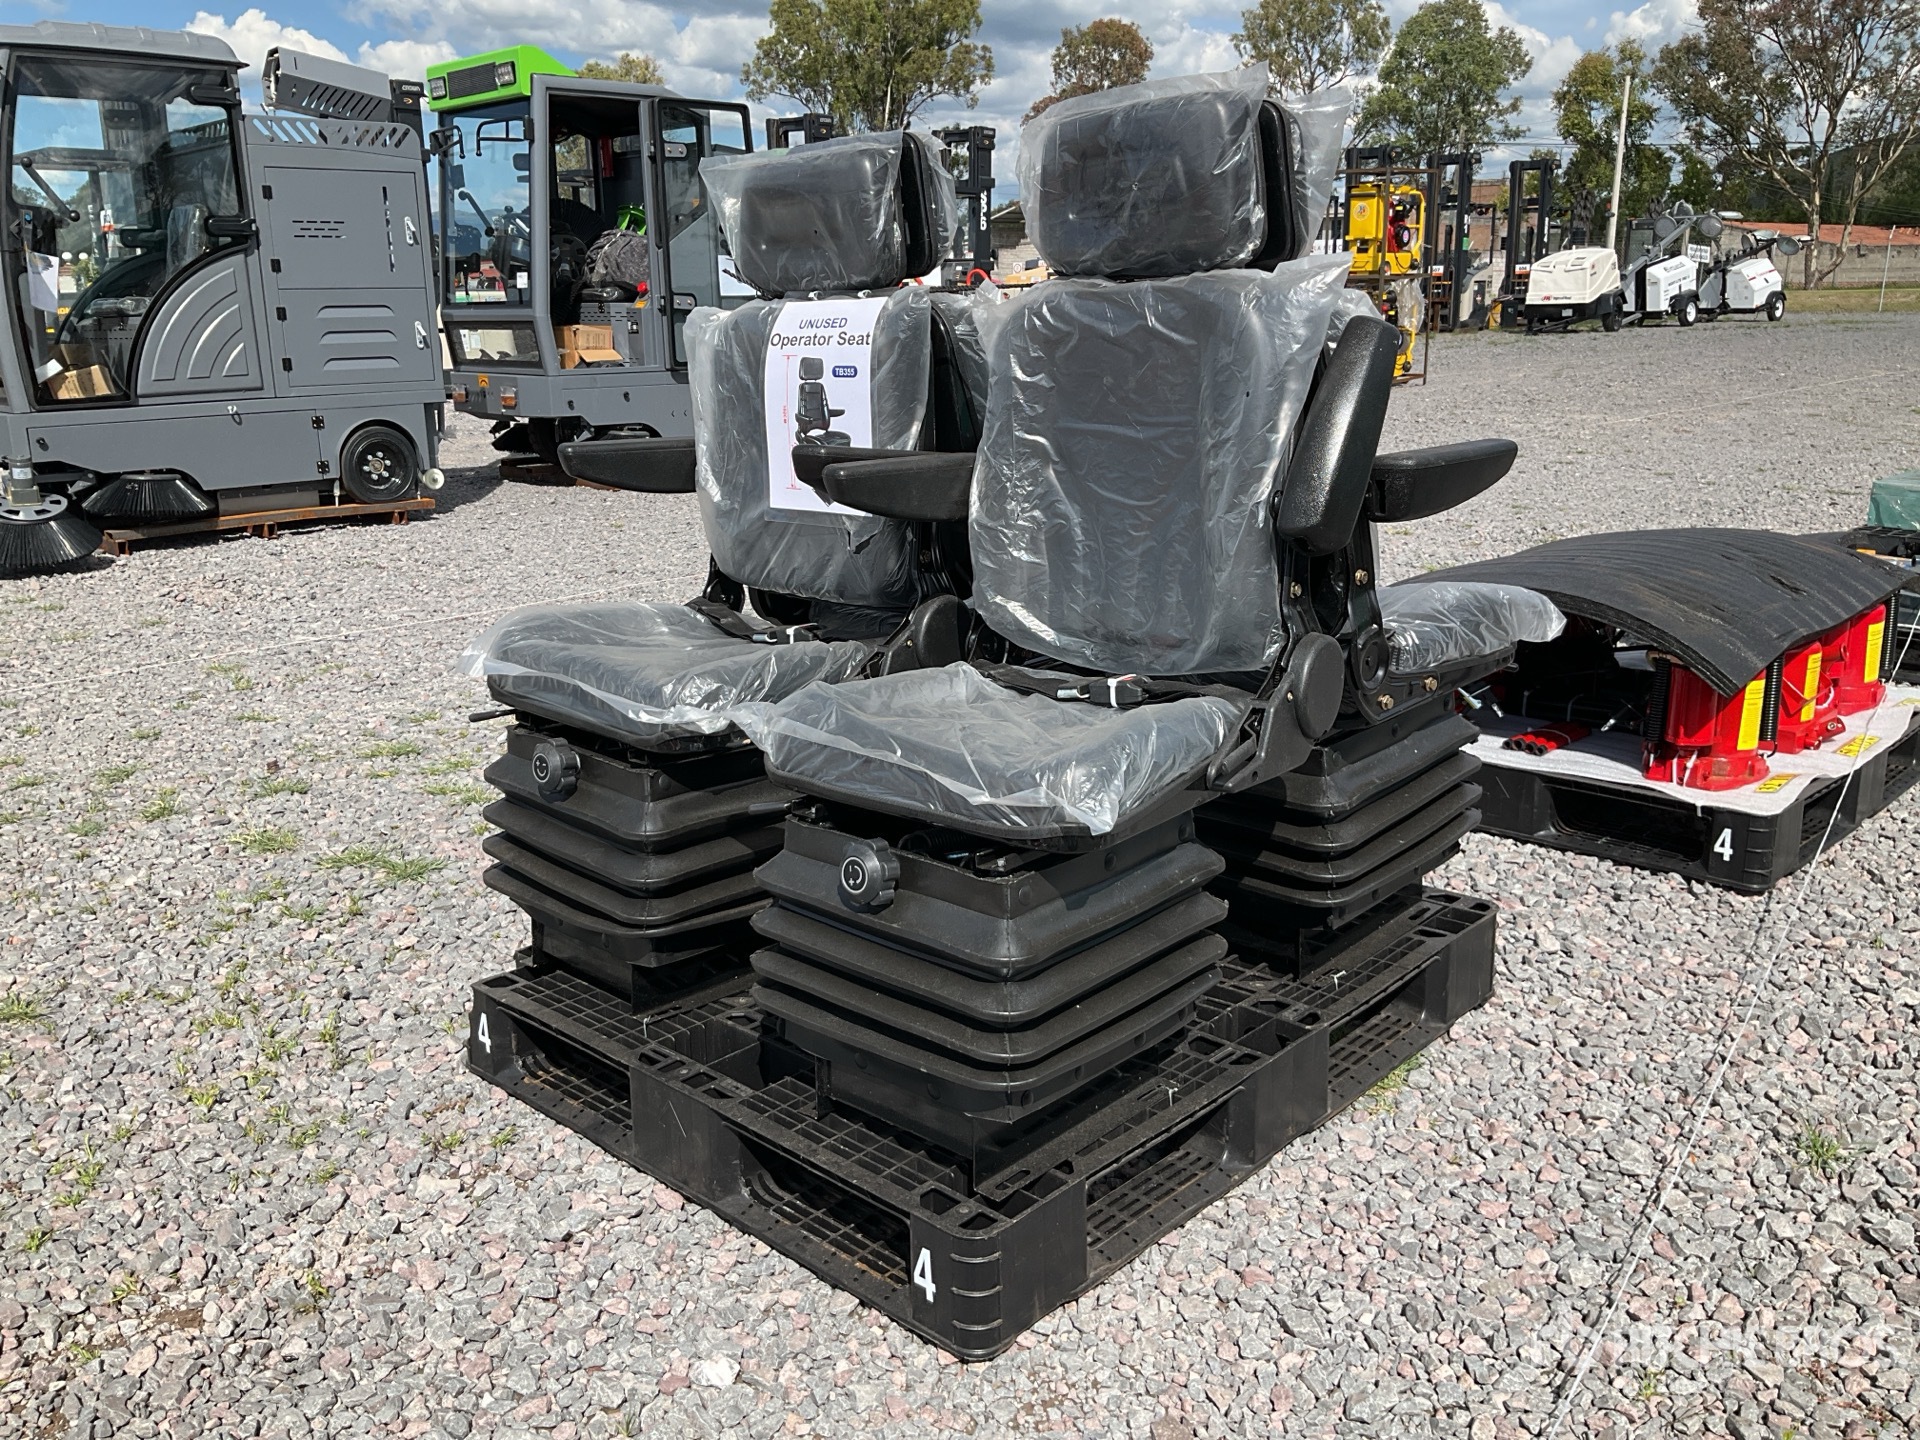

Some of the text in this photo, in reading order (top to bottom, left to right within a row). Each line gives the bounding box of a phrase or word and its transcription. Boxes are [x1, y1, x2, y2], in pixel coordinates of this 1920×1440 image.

[798, 317, 848, 330] UNUSED
[770, 331, 871, 350] Operator Seat
[834, 367, 855, 376] TB355
[1713, 827, 1733, 862] 4
[477, 1012, 492, 1054] 4
[913, 1247, 936, 1303] 4
